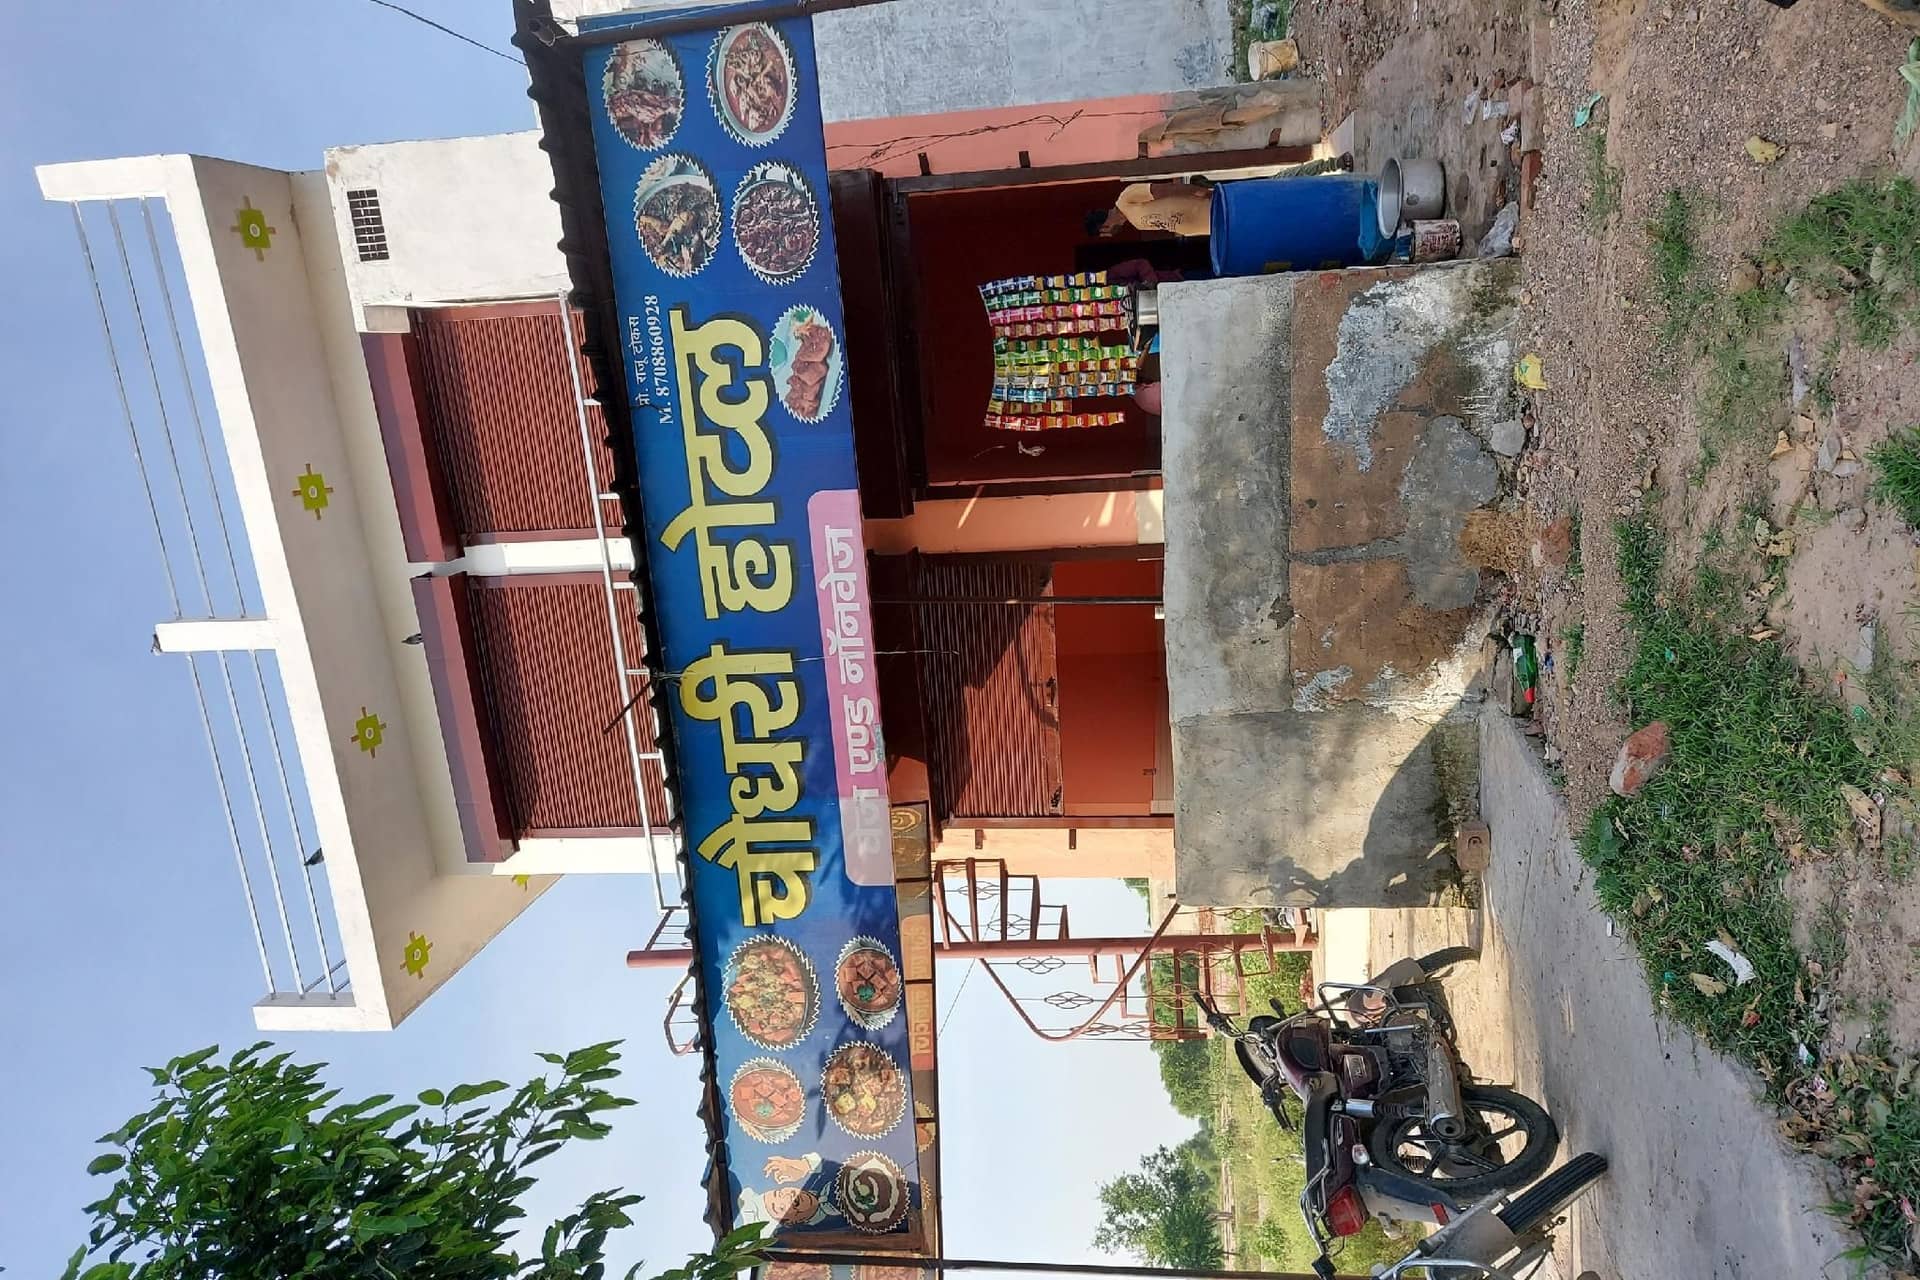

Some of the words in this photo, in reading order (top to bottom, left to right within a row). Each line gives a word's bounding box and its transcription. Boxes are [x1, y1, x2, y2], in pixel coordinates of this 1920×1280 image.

[628, 315, 644, 355] टोकस
[634, 356, 649, 384] राजू
[644, 295, 670, 397] 8708860928
[659, 401, 674, 424] M.
[660, 310, 793, 619] होटल
[819, 525, 866, 684] नॉनवेज
[843, 695, 878, 775] एण्ड
[679, 644, 815, 926] चौधरी
[848, 785, 881, 857] वेज
